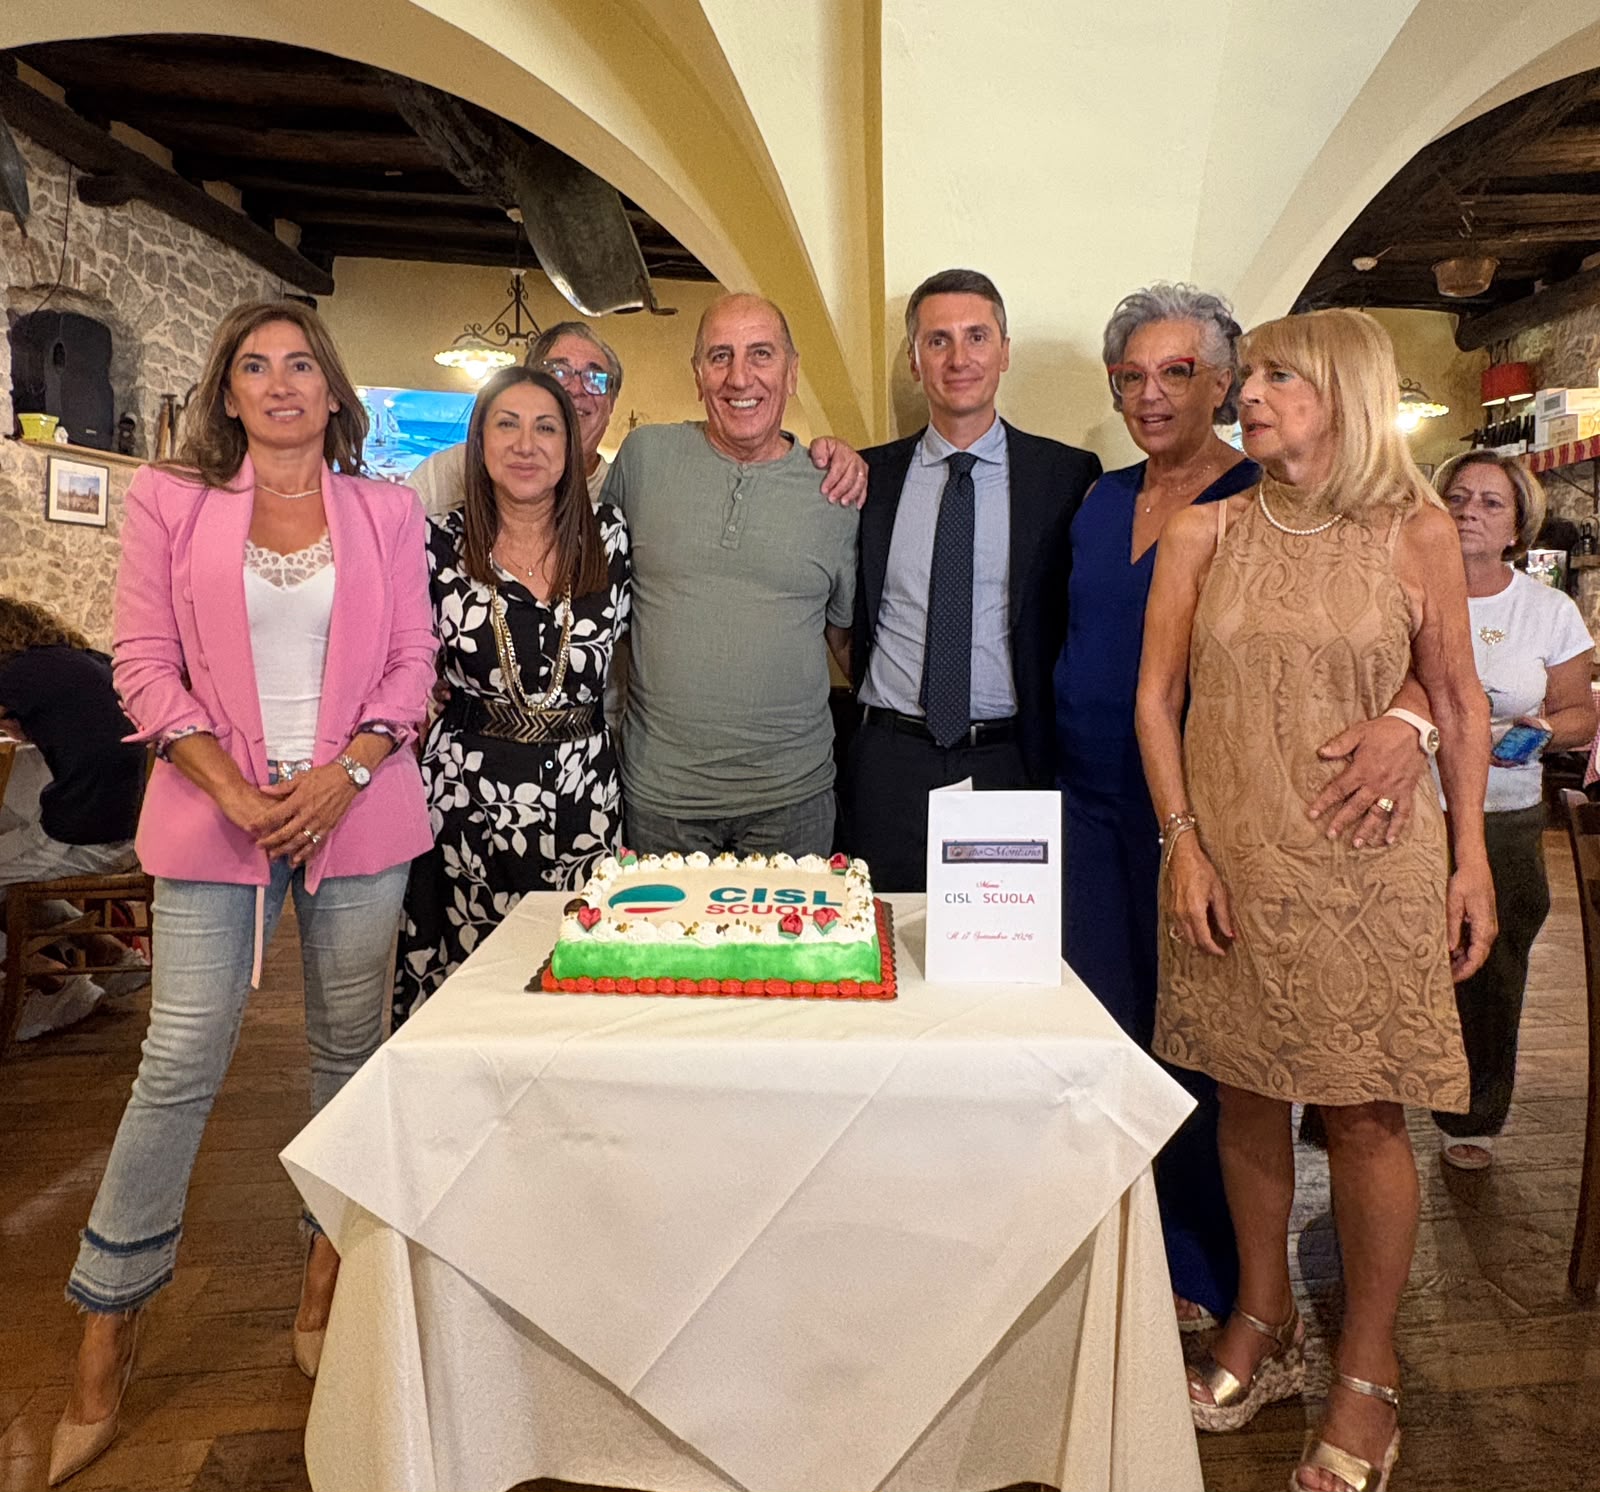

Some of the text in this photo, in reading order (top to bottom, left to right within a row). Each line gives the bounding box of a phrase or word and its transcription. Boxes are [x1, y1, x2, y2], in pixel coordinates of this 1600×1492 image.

[709, 887, 843, 907] CISL
[945, 893, 1035, 904] CISL SCUOLA
